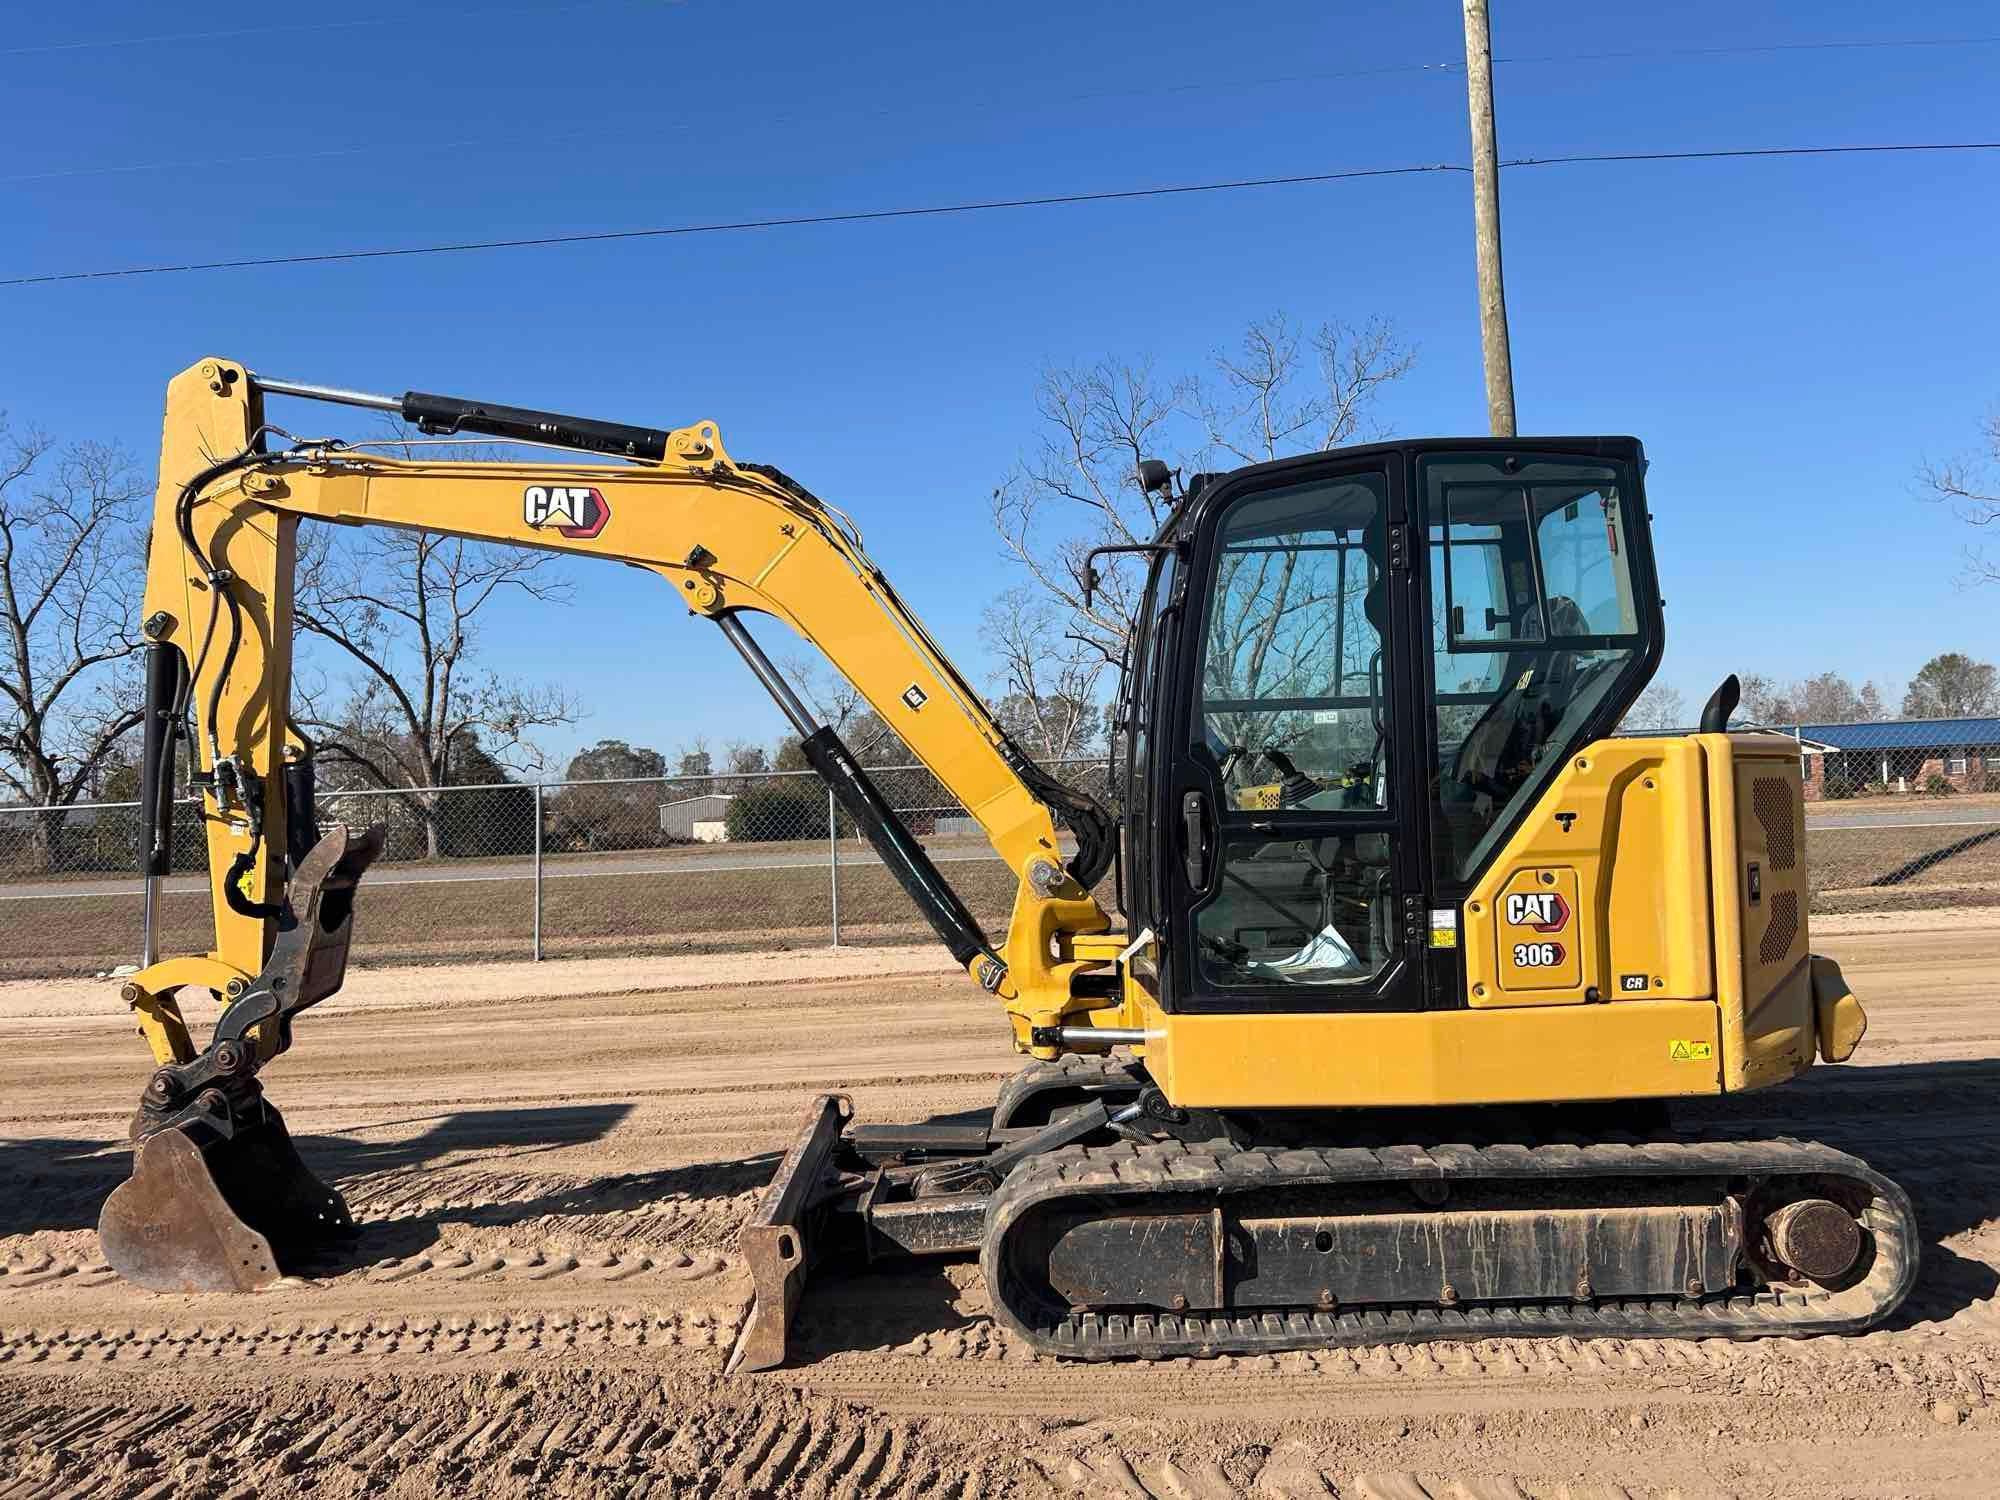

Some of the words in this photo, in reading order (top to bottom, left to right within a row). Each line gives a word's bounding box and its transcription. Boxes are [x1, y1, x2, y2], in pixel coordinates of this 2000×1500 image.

[525, 486, 590, 527] CAT
[1507, 894, 1554, 924] CAT
[1514, 944, 1554, 966] 306
[1626, 977, 1643, 989] CR
